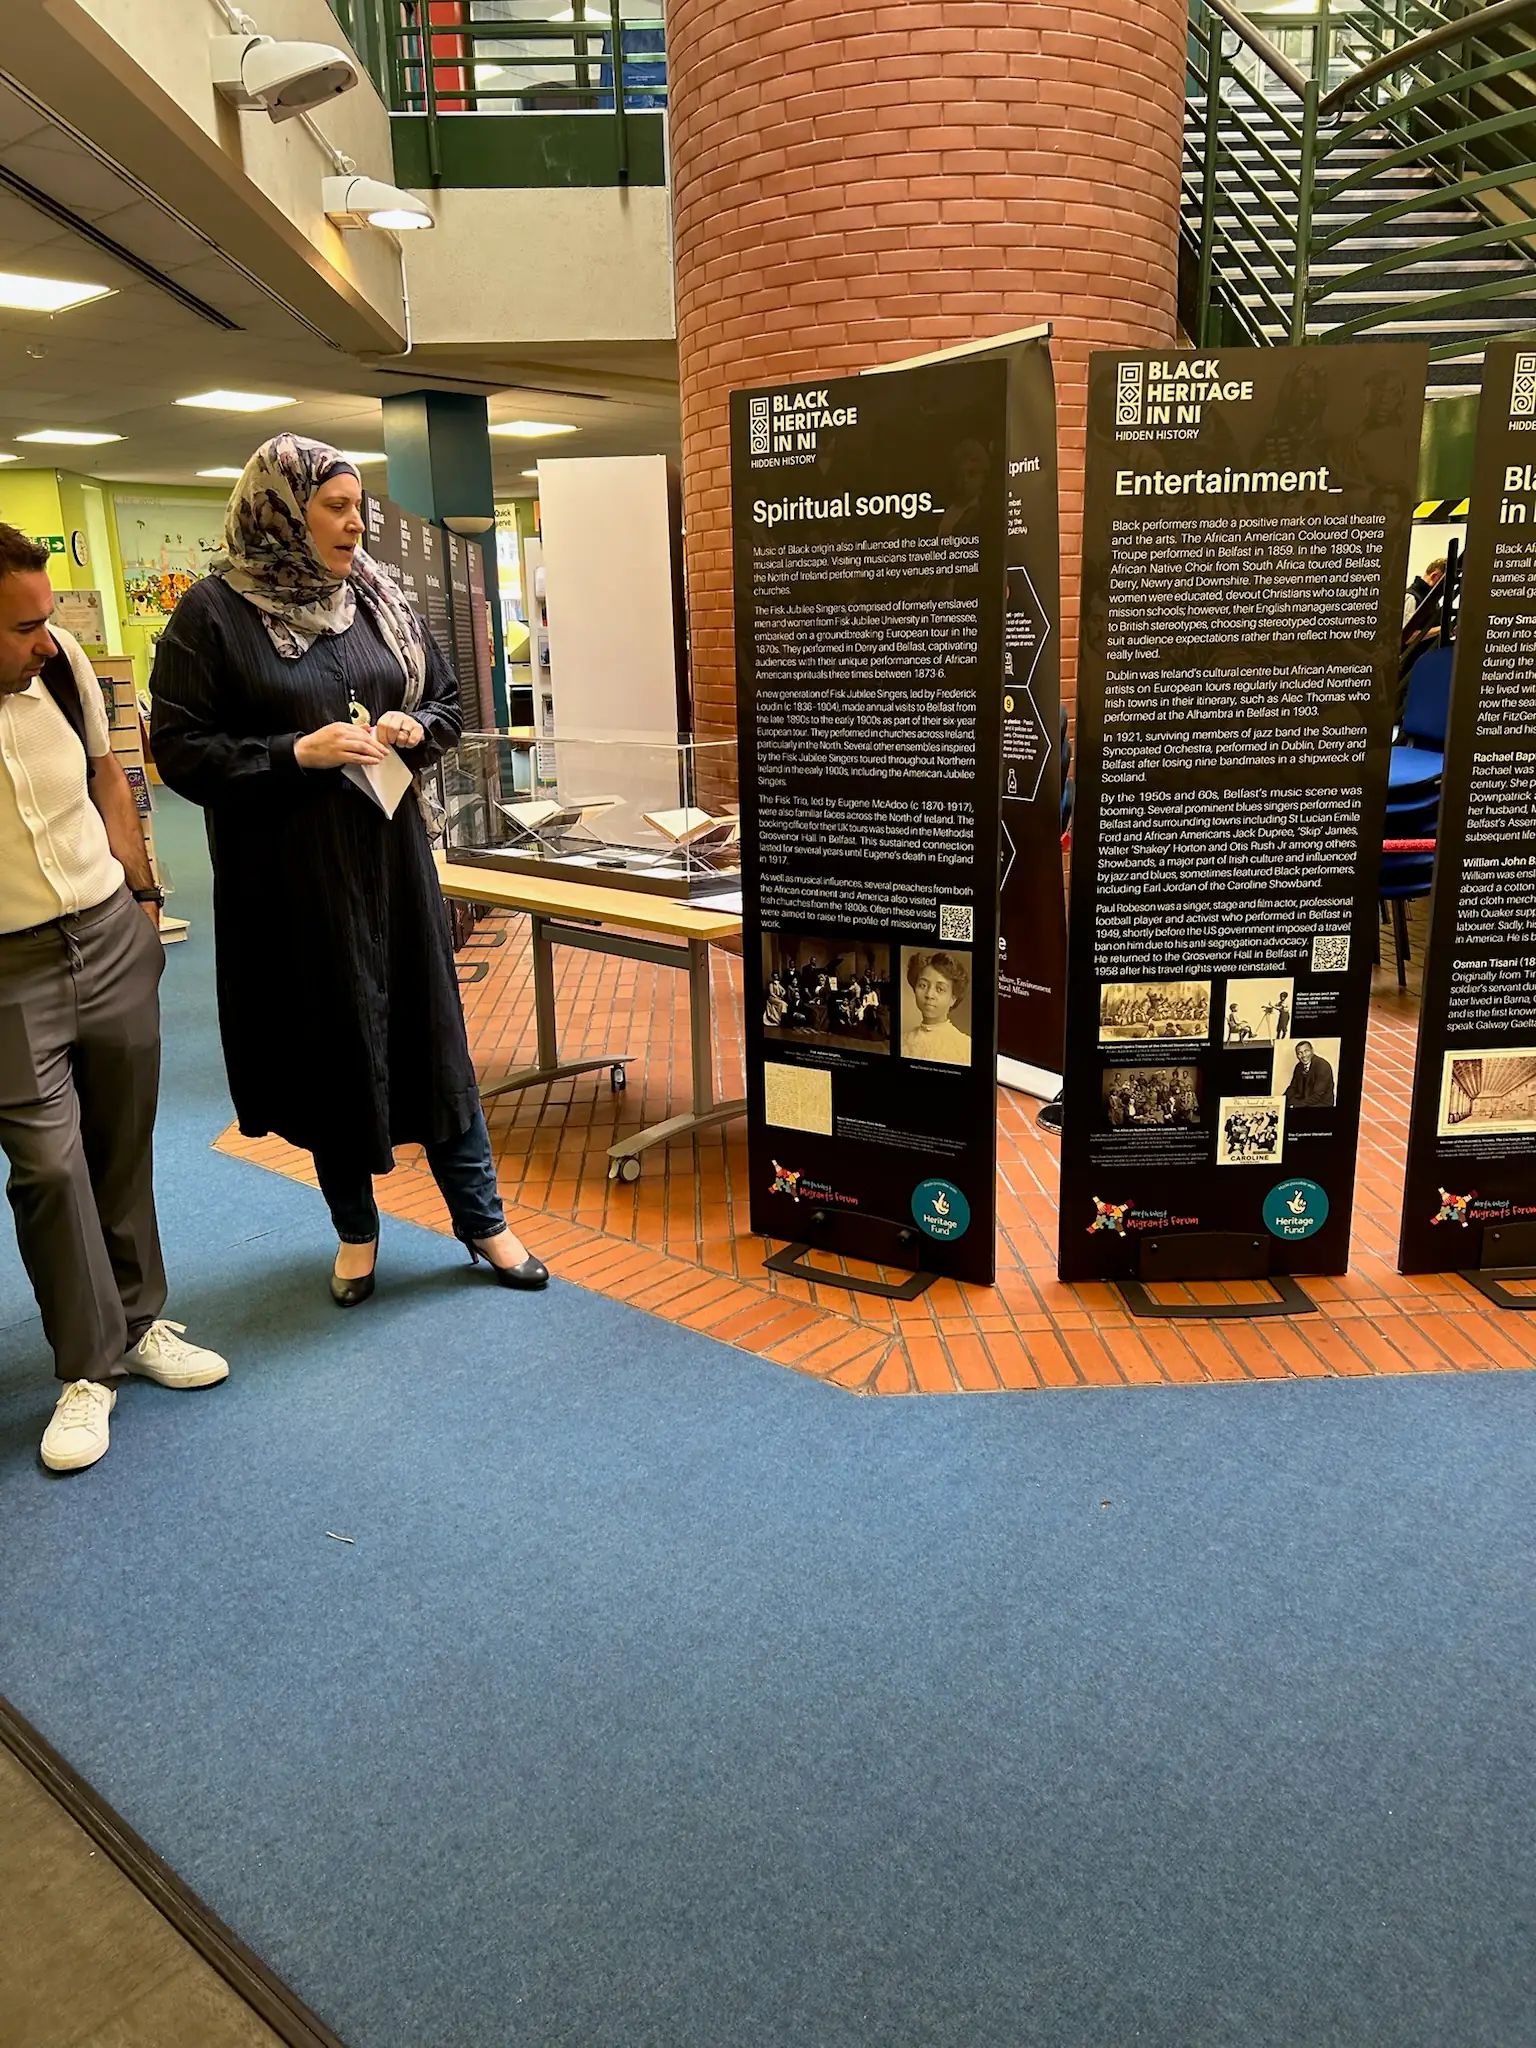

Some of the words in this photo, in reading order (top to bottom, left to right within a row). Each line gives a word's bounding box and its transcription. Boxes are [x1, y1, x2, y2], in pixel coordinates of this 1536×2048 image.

[1148, 360, 1220, 380] BLACK
[1147, 382, 1254, 402] HERITAGE
[772, 390, 829, 412] BLACK
[773, 406, 858, 432] HERITAGE
[1146, 406, 1170, 424] IN
[1176, 405, 1201, 424] NI
[1508, 420, 1536, 431] HIDDE
[1116, 430, 1154, 441] HIDDEN
[1156, 429, 1200, 440] HISTORY
[773, 434, 793, 452] IN
[797, 432, 816, 450] NI
[751, 457, 780, 468] HIDDEN
[782, 454, 816, 466] HISTORY
[1008, 456, 1040, 477] tprint
[1115, 466, 1344, 496] Entertainment_
[494, 509, 511, 518] Quick
[752, 493, 850, 527] Spiritual
[855, 492, 944, 519] songs_
[1500, 498, 1526, 524] in
[1112, 520, 1140, 530] Black
[1142, 519, 1198, 532] performers
[1199, 518, 1228, 528] made
[1239, 517, 1278, 530] positive
[1280, 516, 1306, 526] mark
[1307, 518, 1322, 526] on
[1323, 515, 1348, 525] local
[1349, 514, 1386, 525] theatre
[1111, 535, 1133, 545] and
[1135, 535, 1152, 545] the
[1155, 534, 1177, 544] arts.
[1180, 533, 1202, 544] The
[1204, 532, 1242, 543] African
[1244, 531, 1296, 542] American
[1298, 530, 1349, 541] Coloured
[1350, 529, 1385, 542] Opera
[1111, 549, 1148, 562] Troupe
[1150, 548, 1203, 561] performed
[1206, 547, 1216, 557] in
[1218, 546, 1252, 557] Belfast
[1254, 546, 1264, 556] in
[1267, 545, 1294, 556] 1859.
[1298, 545, 1308, 555] In
[1310, 545, 1327, 555] the
[1330, 544, 1363, 555] 1890s,
[1366, 543, 1383, 553] the
[1496, 543, 1524, 554] Black
[1110, 564, 1147, 574] African
[1149, 563, 1182, 573] Native
[1184, 562, 1213, 572] Choir
[1215, 561, 1240, 572] from
[1242, 560, 1273, 571] South
[1275, 560, 1305, 570] Africa
[1307, 559, 1342, 569] toured
[1344, 558, 1381, 569] Belfast,
[1494, 557, 1503, 568] in
[1506, 556, 1531, 568] small
[1492, 572, 1526, 583] names
[1490, 587, 1526, 598] several
[1488, 615, 1514, 627] Tony
[1516, 614, 1536, 624] Sma
[754, 630, 794, 641] embarked
[796, 632, 807, 640] on
[815, 628, 884, 642] groundbreaking
[886, 628, 929, 640] European
[930, 627, 949, 637] tour
[951, 627, 961, 637] in
[962, 627, 978, 637] the
[1486, 629, 1510, 640] Born
[1512, 629, 1532, 638] into
[1482, 657, 1516, 668] during
[1517, 656, 1534, 666] the
[1480, 684, 1495, 694] He
[1496, 684, 1520, 694] lived
[1478, 700, 1500, 708] now
[1502, 698, 1517, 708] the
[1476, 712, 1500, 722] After
[1103, 732, 1113, 742] In
[1116, 732, 1142, 743] 1921,
[1145, 730, 1190, 743] surviving
[1192, 729, 1240, 740] members
[1240, 728, 1252, 738] of
[1253, 728, 1273, 740] jazz
[1274, 727, 1301, 737] band
[1303, 726, 1320, 737] the
[1322, 725, 1368, 736] Southern
[1476, 725, 1502, 736] Small
[1504, 724, 1523, 735] and
[1102, 745, 1162, 758] Syncopated
[1163, 743, 1213, 755] Orchestra,
[1215, 741, 1267, 755] performed
[1269, 741, 1279, 751] in
[1281, 740, 1315, 752] Dublin,
[1318, 739, 1345, 752] Derry
[1346, 738, 1366, 749] and
[1102, 759, 1135, 769] Belfast
[1137, 758, 1160, 768] after
[1162, 757, 1192, 770] losing
[1194, 756, 1217, 767] nine
[1219, 755, 1276, 766] bandmates
[1278, 754, 1287, 764] in
[1298, 752, 1349, 766] shipwreck
[1351, 752, 1366, 762] off
[1473, 752, 1514, 762] Rachael
[1472, 765, 1512, 775] Rachael
[1514, 766, 1534, 774] was
[1101, 771, 1147, 783] Scotland.
[1470, 780, 1508, 790] century.
[1510, 778, 1528, 788] She
[1469, 791, 1532, 803] Downpatrick
[1468, 805, 1484, 815] her
[1486, 804, 1528, 815] husband,
[1466, 818, 1505, 829] Belfast's
[1465, 832, 1520, 842] subsequent
[1463, 858, 1500, 867] William
[1501, 856, 1527, 866] John
[1462, 870, 1495, 880] William
[1496, 871, 1515, 879] was
[1460, 883, 1494, 893] aboard
[1496, 884, 1502, 892] a
[1504, 882, 1535, 892] cotton
[1458, 896, 1478, 906] and
[1480, 896, 1504, 905] cloth
[1458, 909, 1479, 918] With
[1480, 908, 1514, 918] Quaker
[1453, 960, 1487, 970] Osman
[1489, 958, 1518, 968] Tisani
[1452, 971, 1497, 983] Originally
[1499, 970, 1521, 980] from
[1447, 1021, 1474, 1032] speak
[1476, 1021, 1509, 1030] Galway
[800, 1188, 834, 1201] Migrants
[835, 1192, 858, 1205] Forum
[1469, 1208, 1510, 1220] Migrants
[923, 1214, 958, 1229] Heritage
[1127, 1218, 1169, 1230] Migrants
[1171, 1216, 1198, 1225] Forum
[1276, 1217, 1314, 1227] Heritage
[931, 1224, 950, 1236] Fund
[1284, 1225, 1305, 1234] Fund
